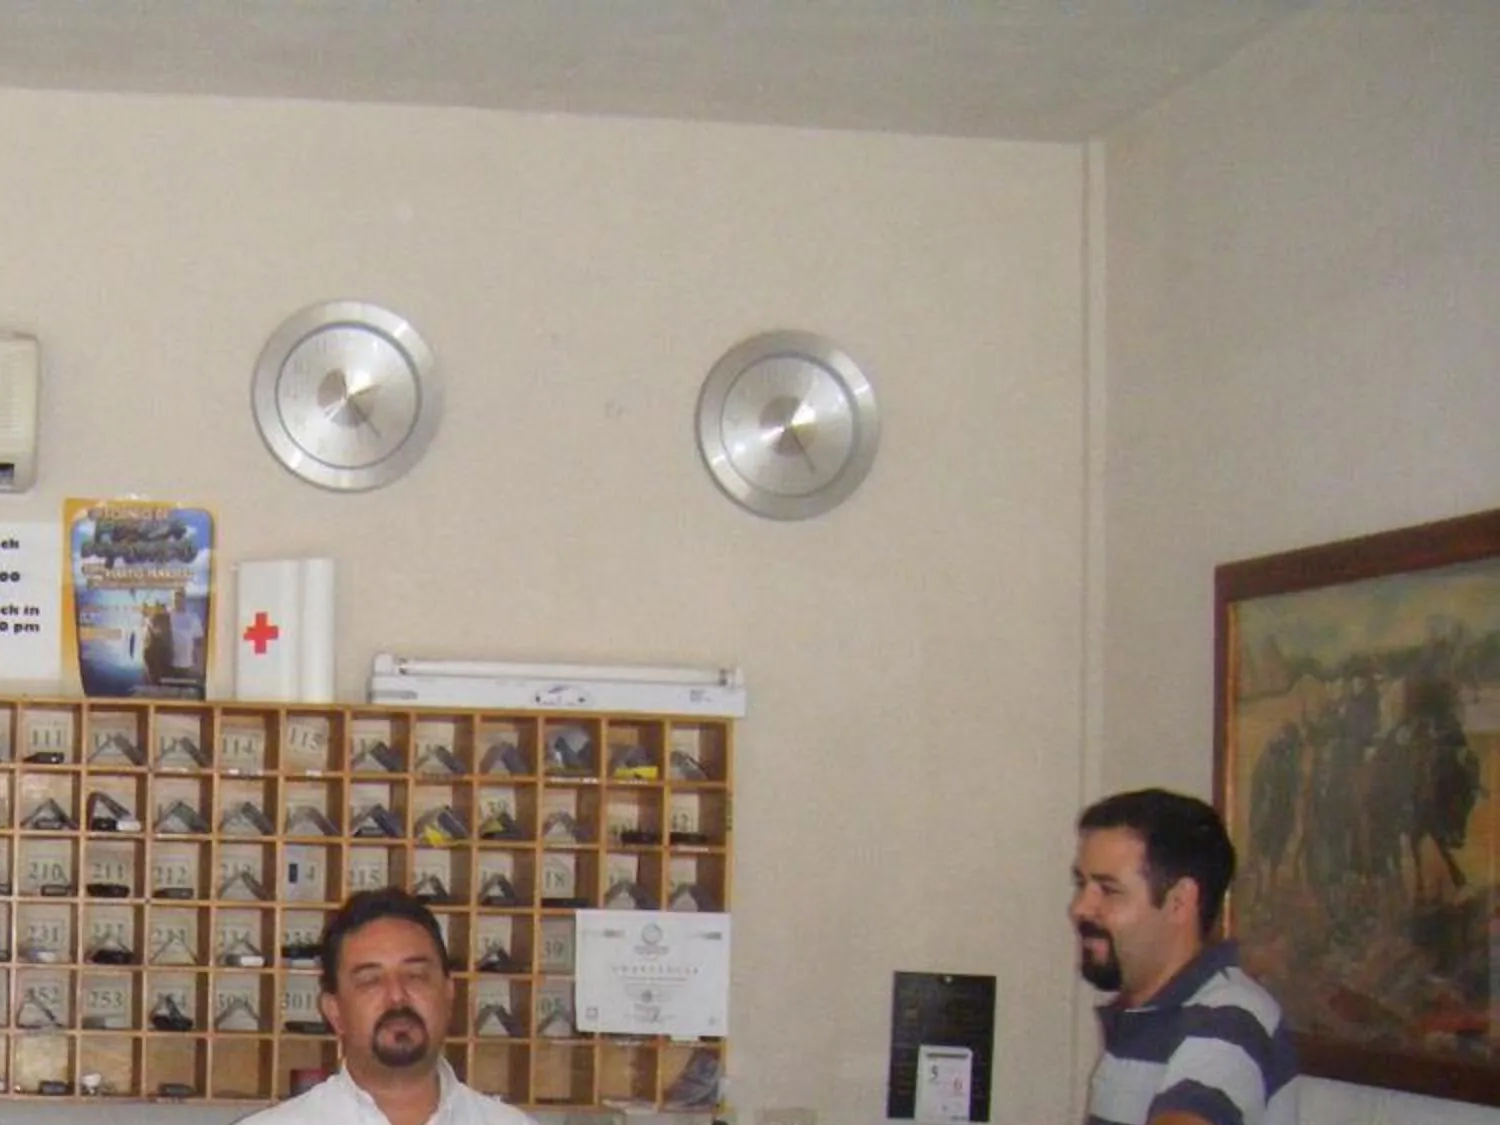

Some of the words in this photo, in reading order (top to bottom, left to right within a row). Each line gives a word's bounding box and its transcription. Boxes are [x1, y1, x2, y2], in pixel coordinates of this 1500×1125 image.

[24, 606, 40, 616] in
[13, 623, 40, 634] pm
[32, 729, 63, 747] 111
[290, 727, 322, 751] 115
[29, 863, 64, 880] 210
[92, 863, 126, 880] 211
